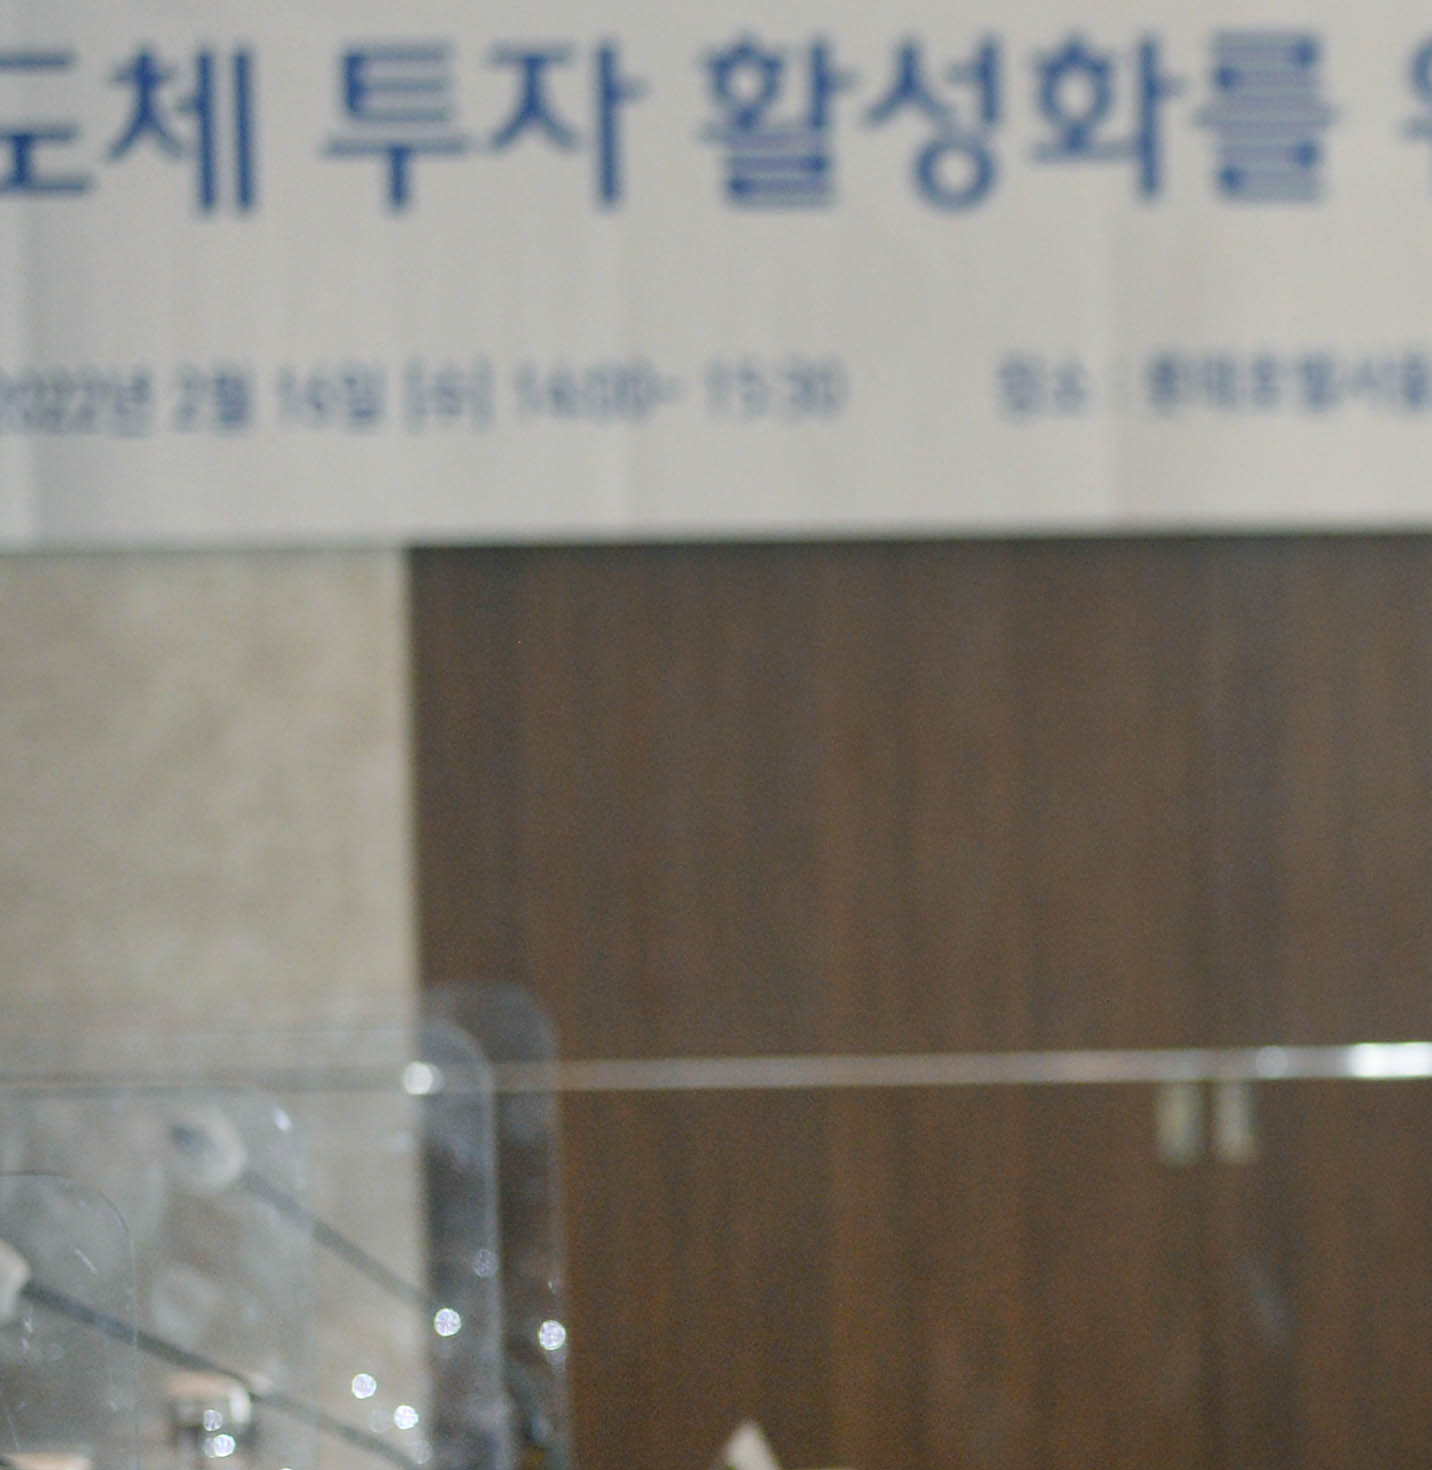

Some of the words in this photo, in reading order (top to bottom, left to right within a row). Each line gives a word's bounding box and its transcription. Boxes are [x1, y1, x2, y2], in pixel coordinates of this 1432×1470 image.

[0, 47, 256, 215] 도체
[325, 41, 645, 214] 투자
[700, 31, 1337, 213] 활성화를
